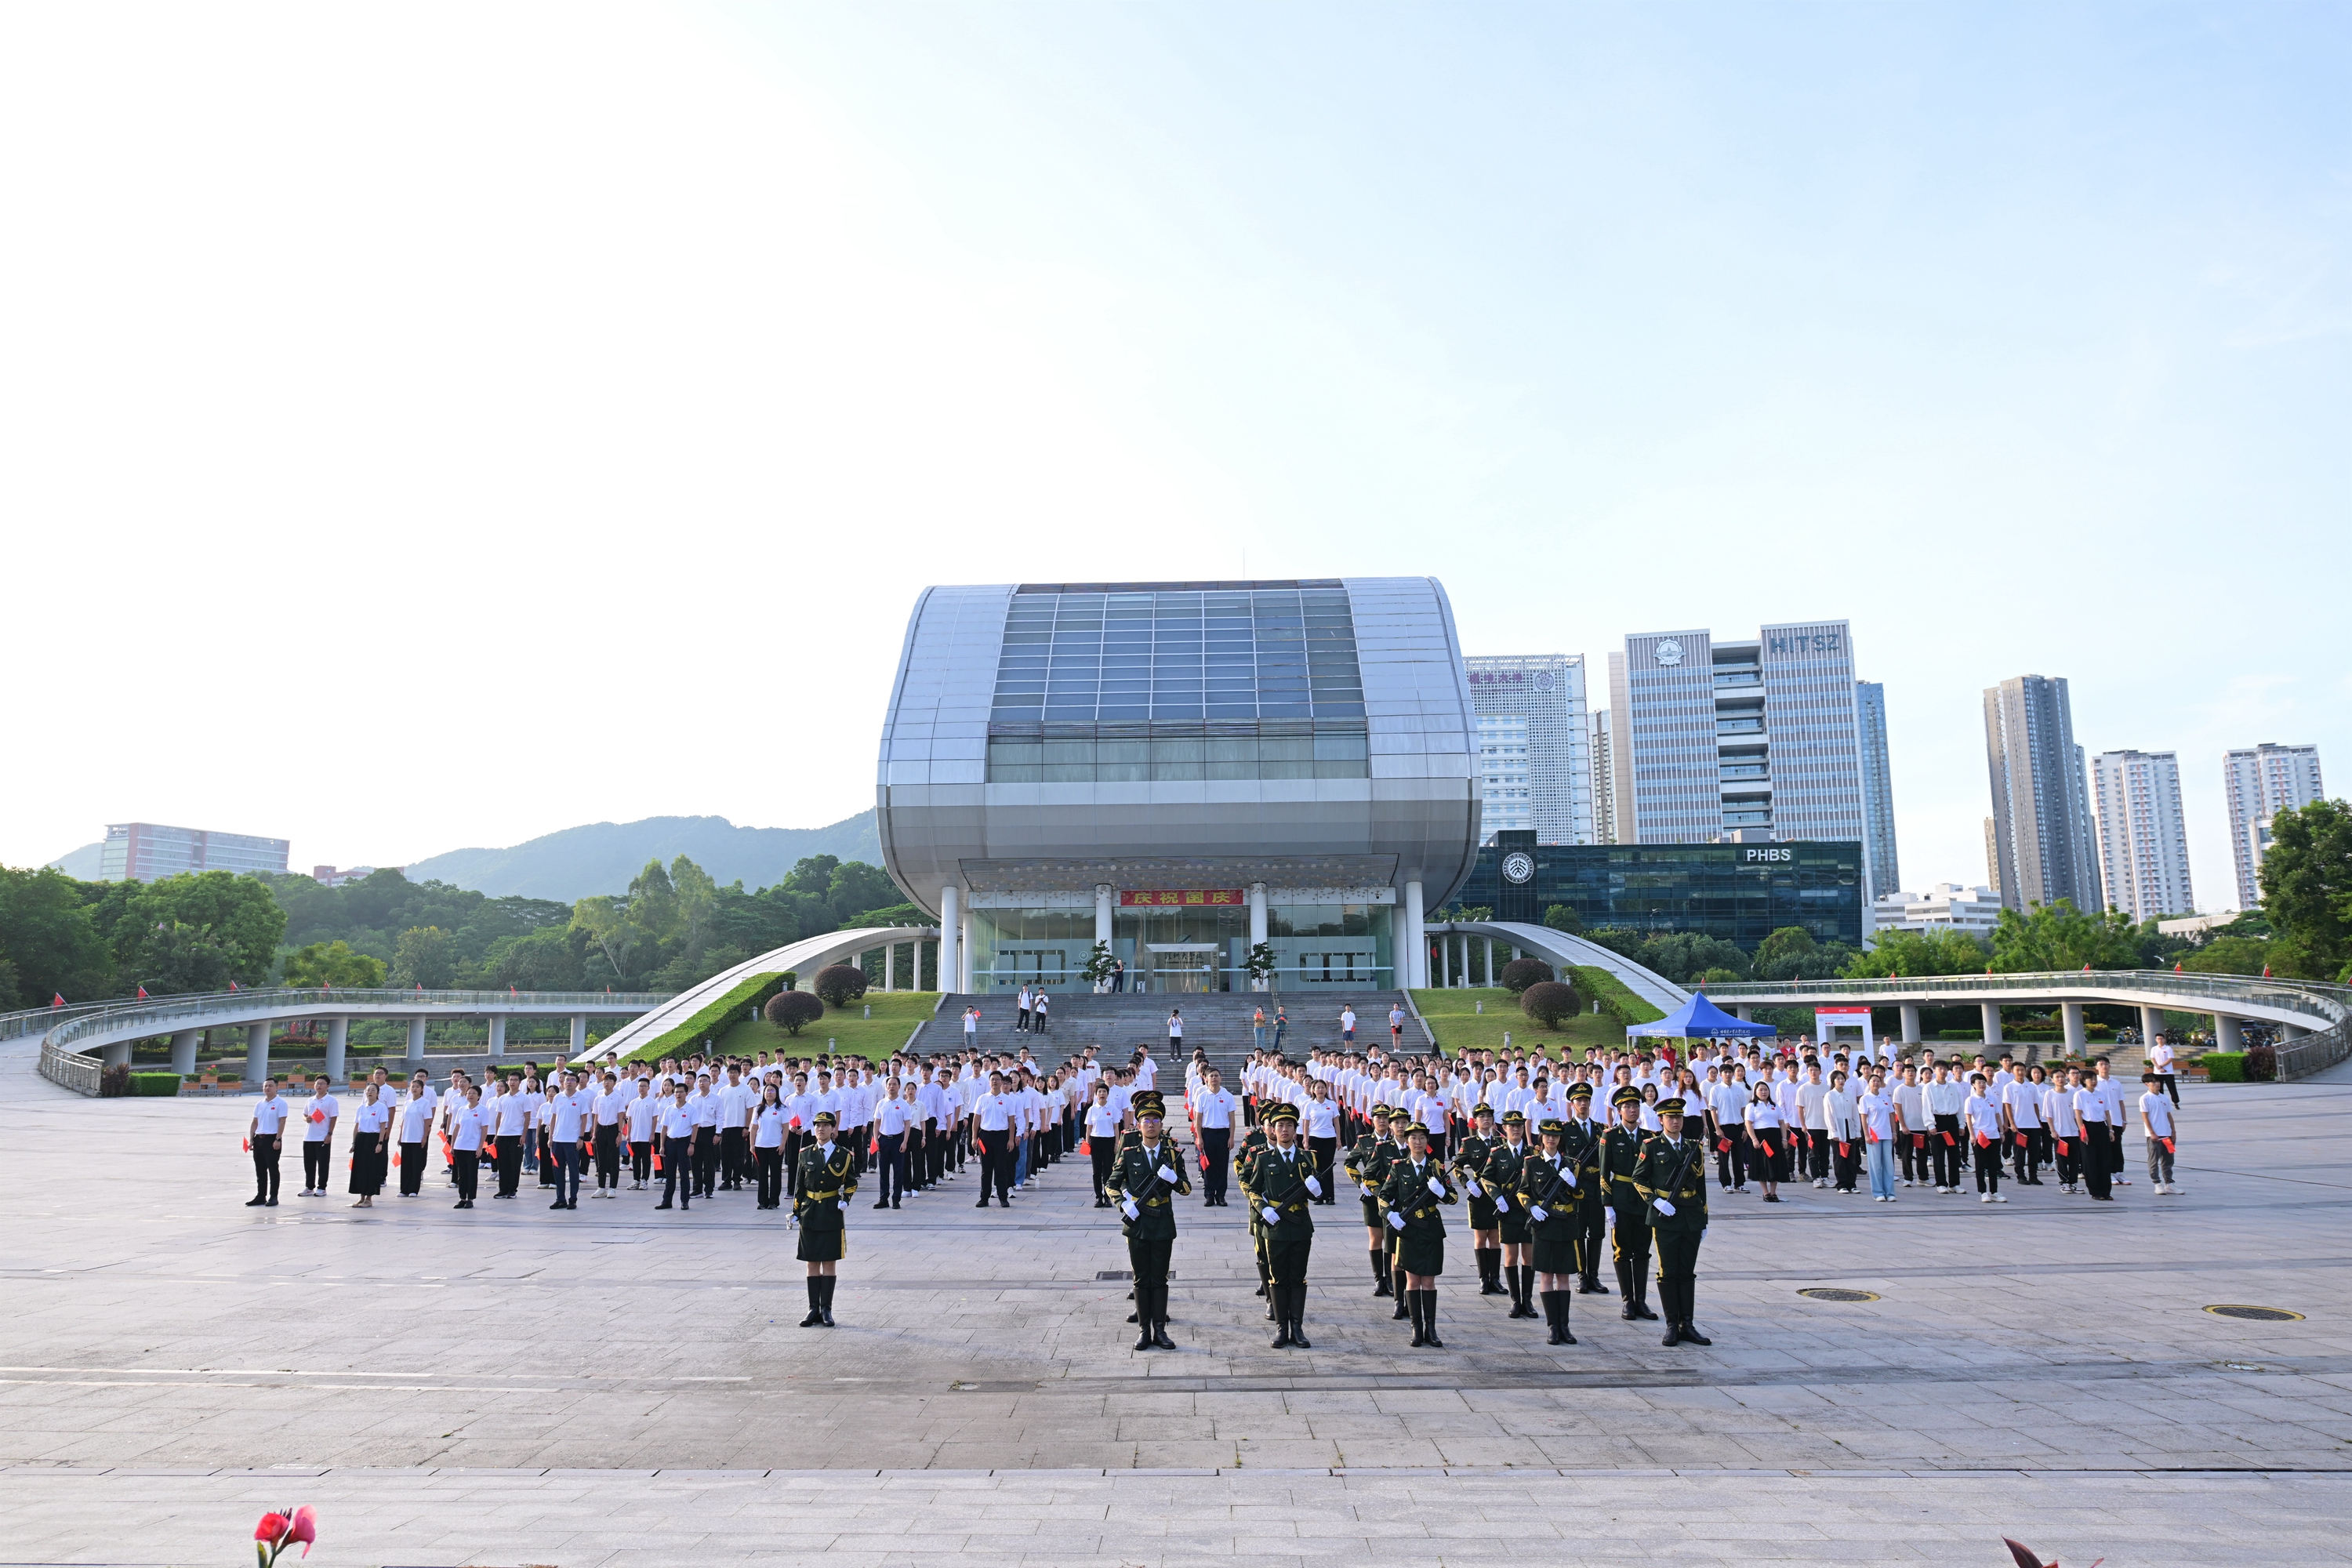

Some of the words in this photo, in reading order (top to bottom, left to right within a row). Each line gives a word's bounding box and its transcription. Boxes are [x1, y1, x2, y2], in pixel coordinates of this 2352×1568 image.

[1771, 634, 1839, 653] HITSZ
[1747, 849, 1791, 862] PHBS
[1134, 891, 1230, 904] 庆祝国庆
